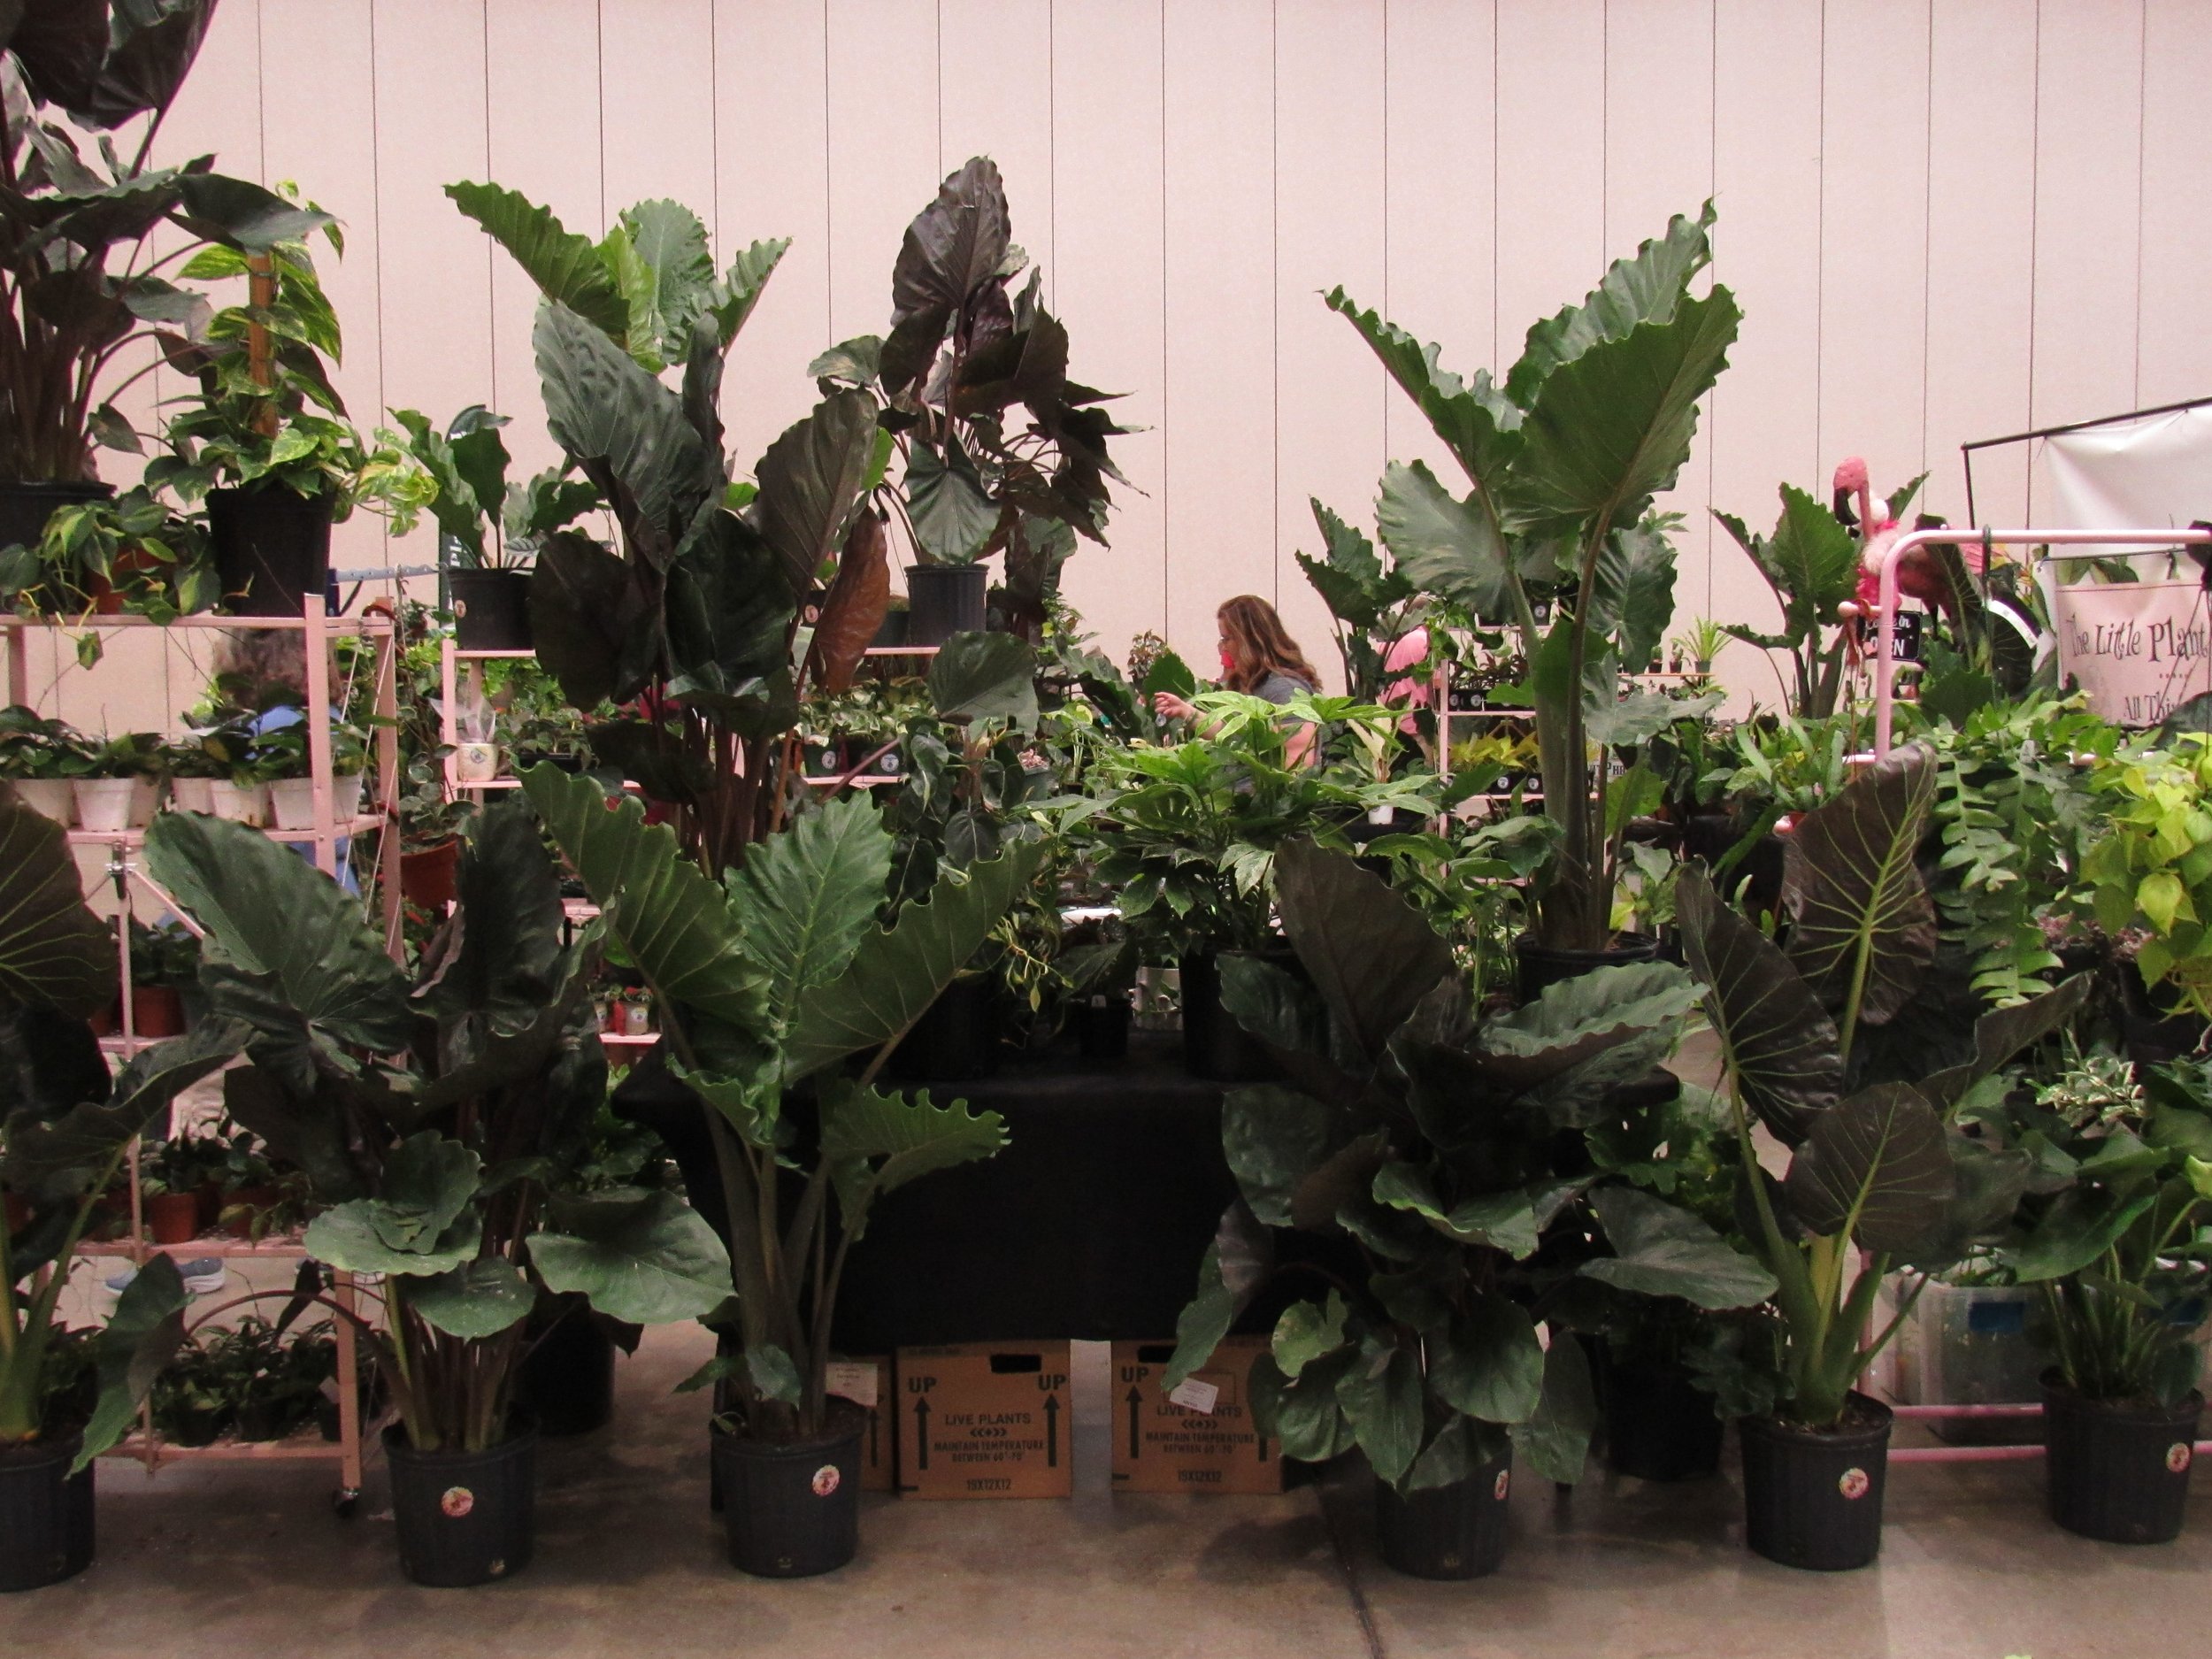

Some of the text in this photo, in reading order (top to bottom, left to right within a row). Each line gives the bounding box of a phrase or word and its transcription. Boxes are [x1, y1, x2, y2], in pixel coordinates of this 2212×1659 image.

[2094, 618, 2140, 660] Little
[2147, 616, 2208, 662] Plant
[1121, 1367, 1148, 1382] UP
[908, 1377, 937, 1393] UP
[1038, 1374, 1067, 1391] UP
[1157, 1405, 1186, 1416] LIVE
[945, 1413, 1032, 1425] LIVE PLANTS
[1146, 1432, 1255, 1444] MAINTAIN TEMPERATURE
[934, 1440, 1043, 1452] MAINTAIN TEMPERATURE
[1164, 1444, 1201, 1454] BETWEEN
[952, 1453, 990, 1463] BETWEEN
